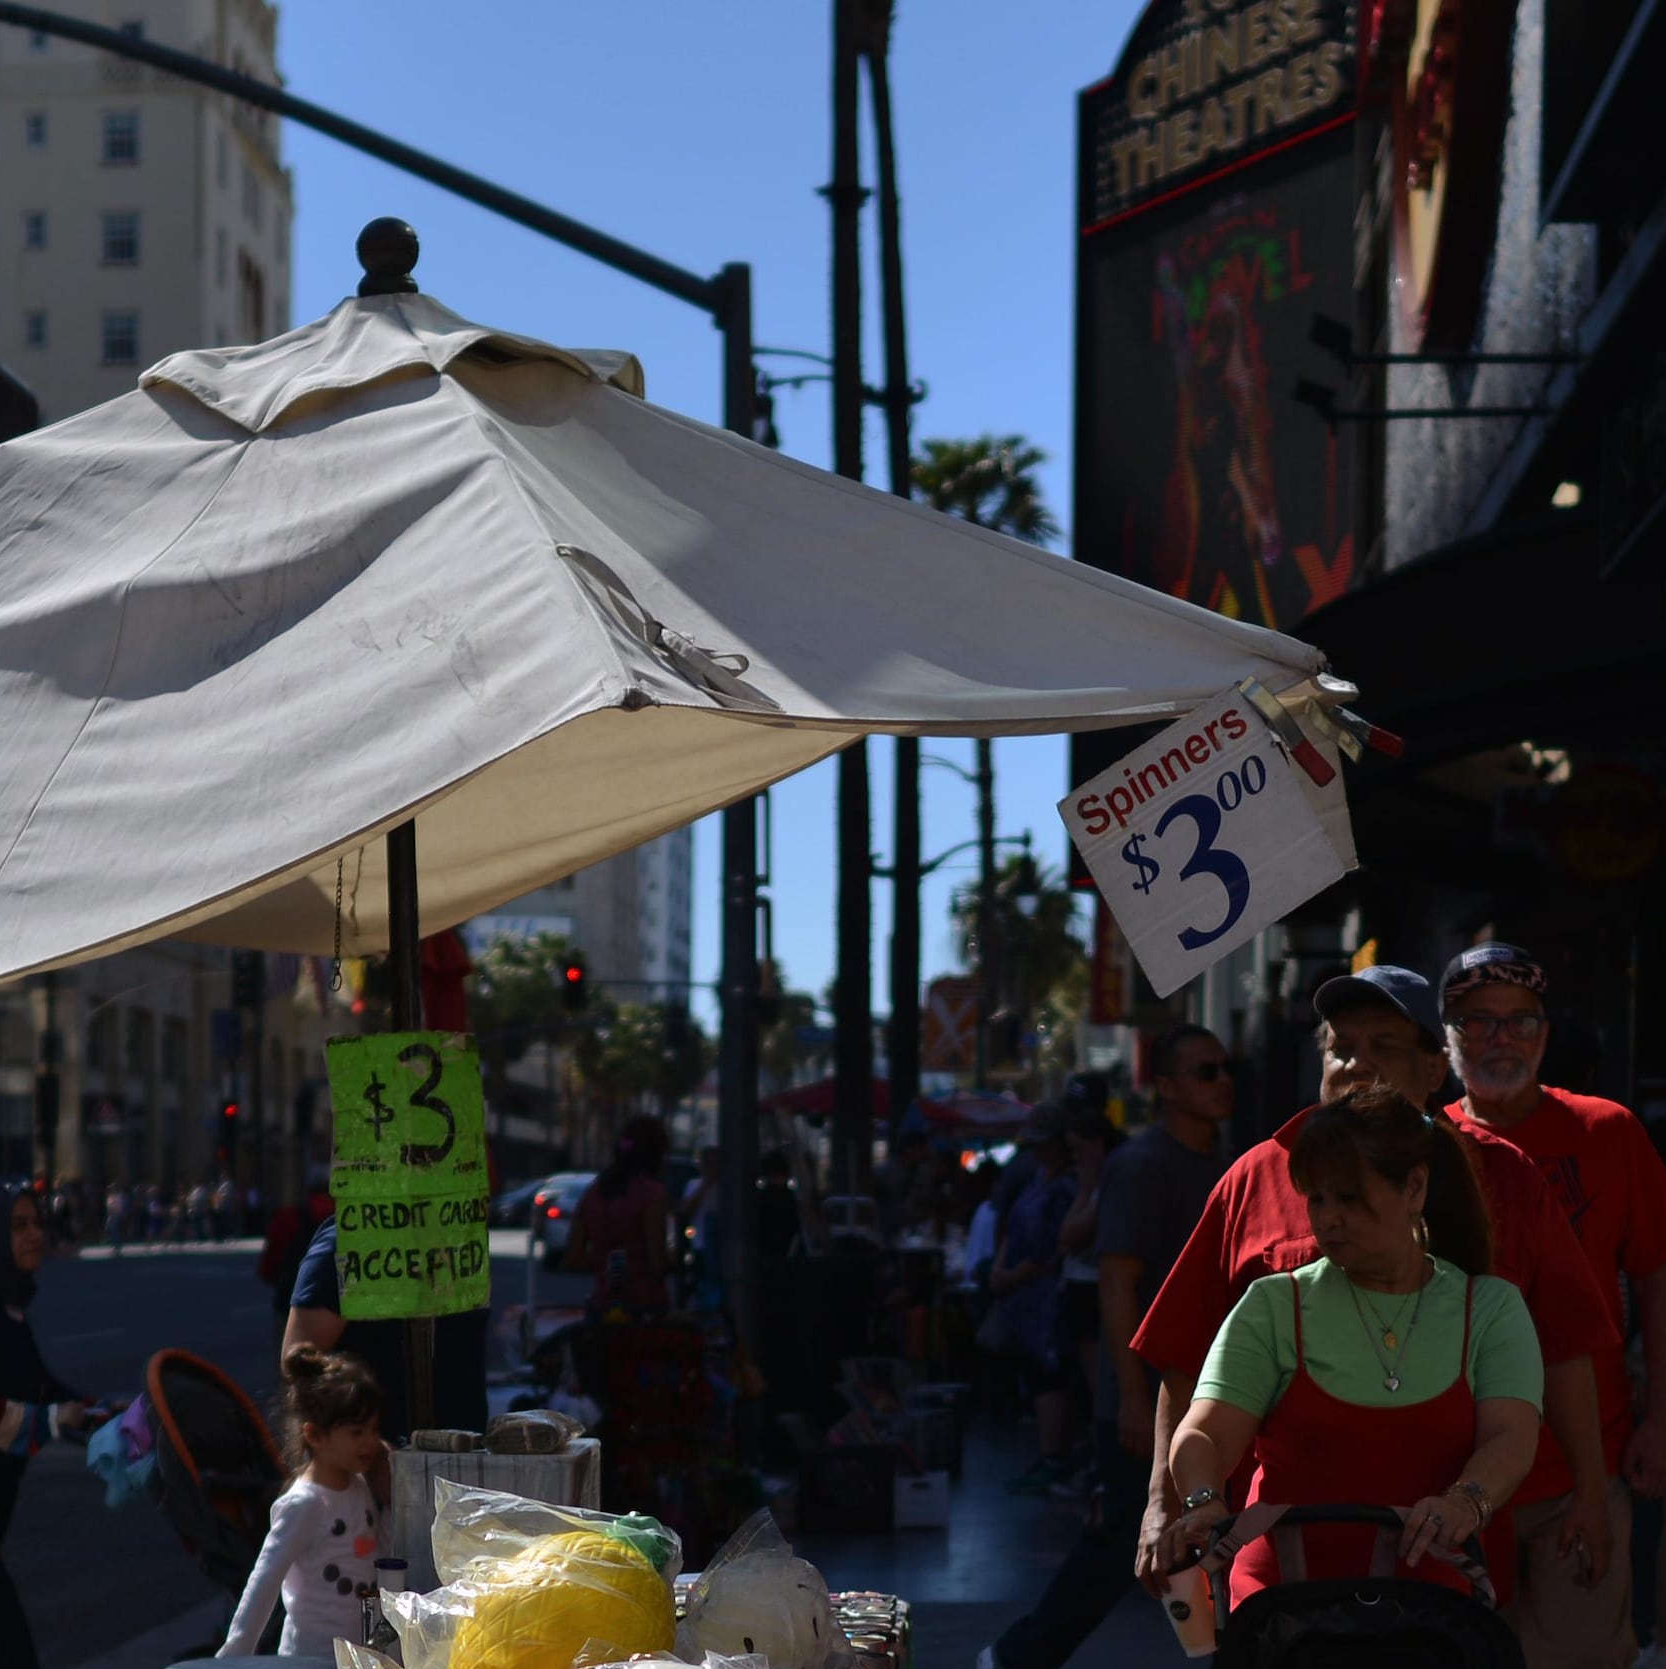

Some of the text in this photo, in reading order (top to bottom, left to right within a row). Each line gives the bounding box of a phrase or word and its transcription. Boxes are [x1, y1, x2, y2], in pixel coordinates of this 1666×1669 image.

[1108, 42, 1343, 198] THEATRES
[1126, 0, 1327, 120] CHINESE
[1076, 709, 1248, 835] Spinners
[340, 1202, 432, 1231] CREDIT
